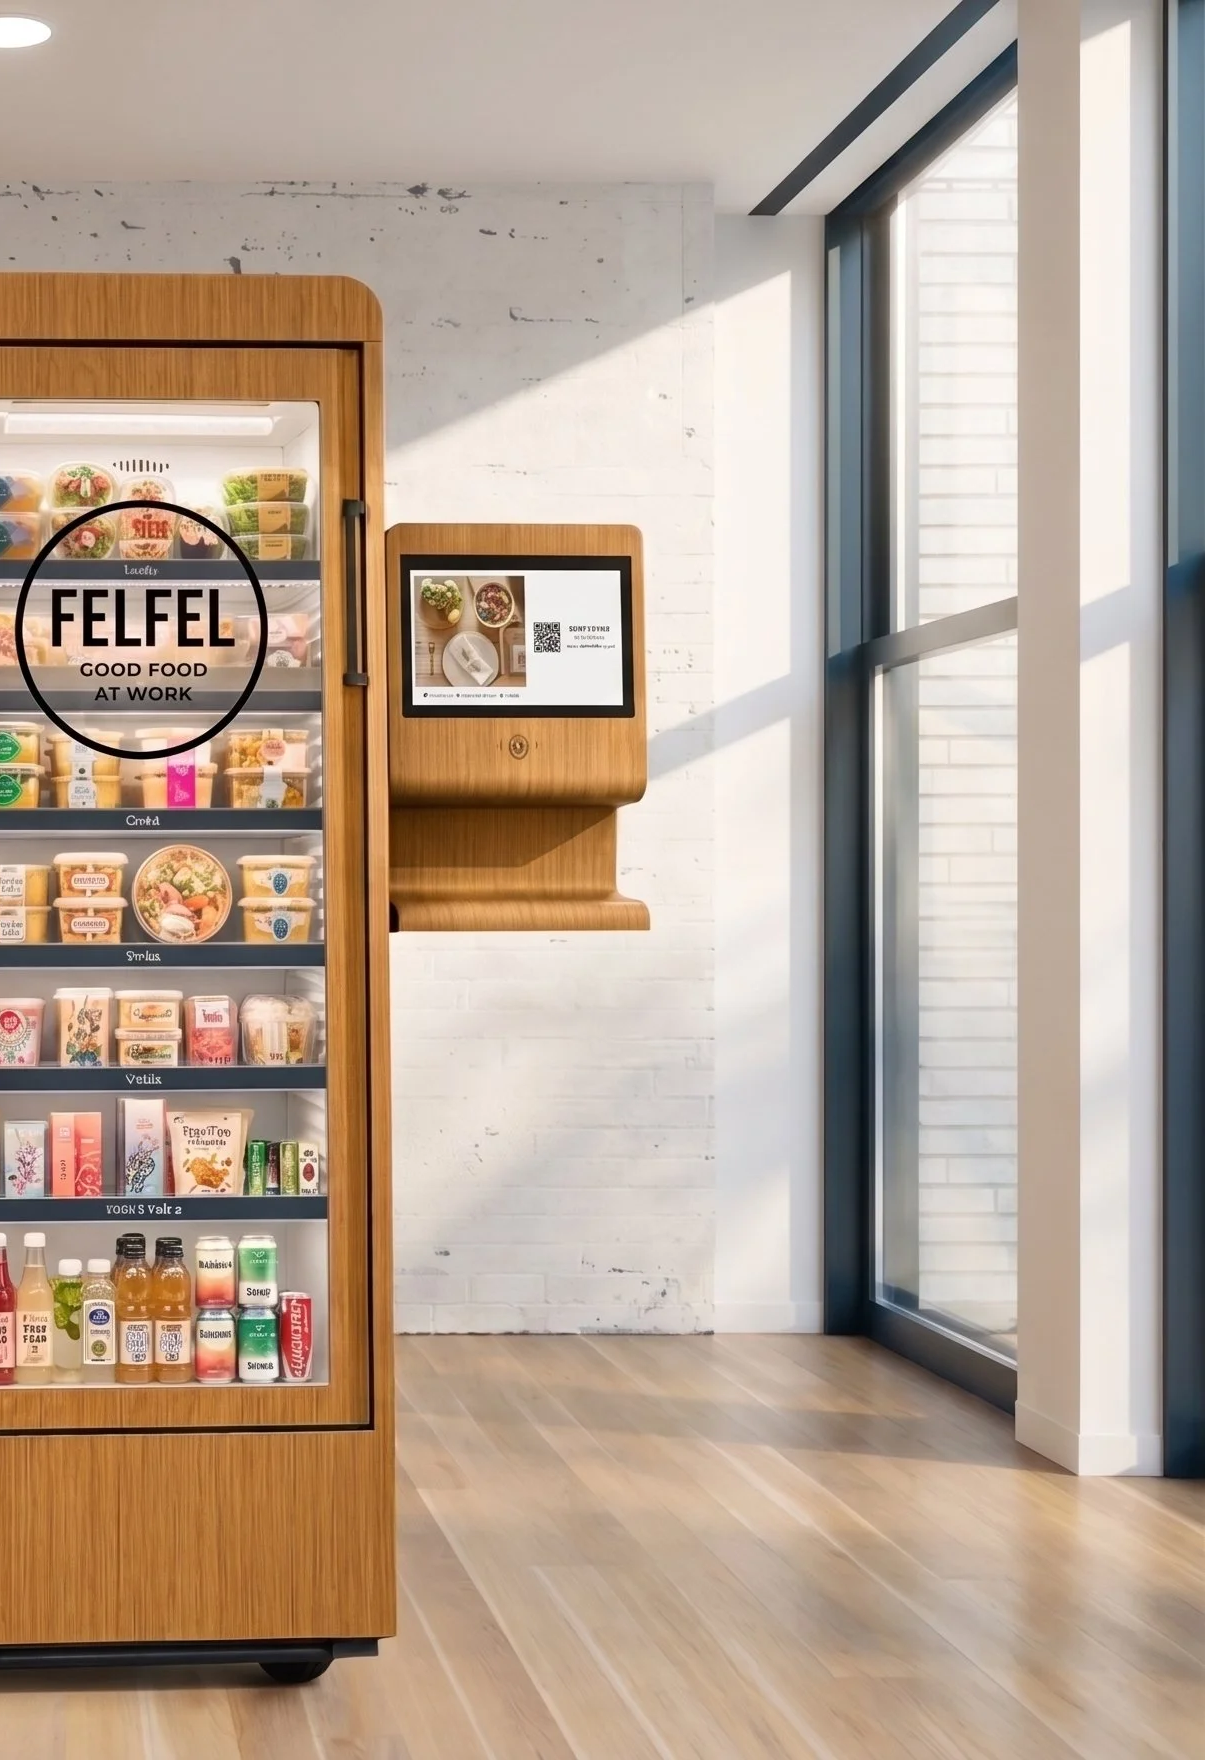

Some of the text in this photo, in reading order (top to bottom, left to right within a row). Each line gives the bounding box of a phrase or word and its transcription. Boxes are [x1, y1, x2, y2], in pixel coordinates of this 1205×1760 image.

[52, 589, 235, 647] FELFEL
[80, 663, 207, 677] GOOD FOOD
[94, 686, 193, 701] AT WORK
